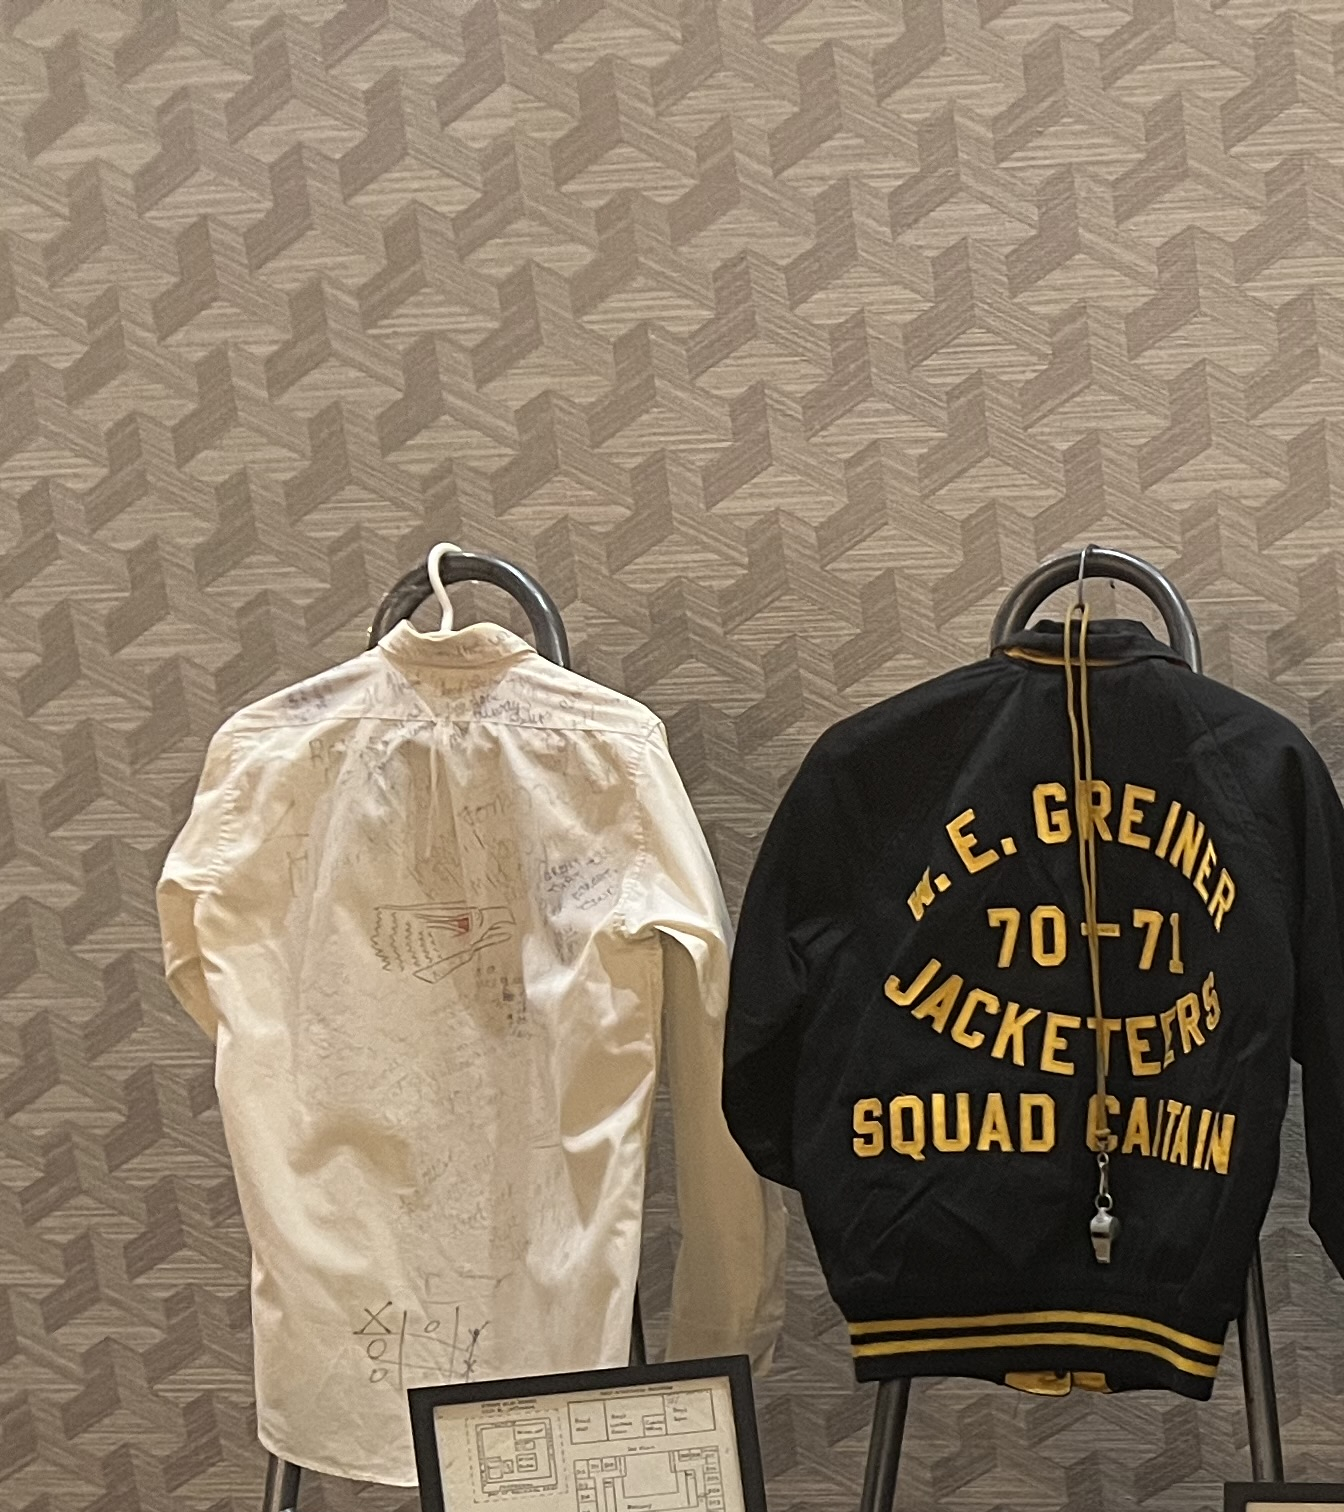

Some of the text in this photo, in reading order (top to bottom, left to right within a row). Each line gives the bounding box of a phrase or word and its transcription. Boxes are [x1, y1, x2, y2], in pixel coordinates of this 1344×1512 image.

[1031, 779, 1238, 933] GREINER
[987, 905, 1185, 974] 70-71
[853, 1092, 1055, 1162] SQUAD
